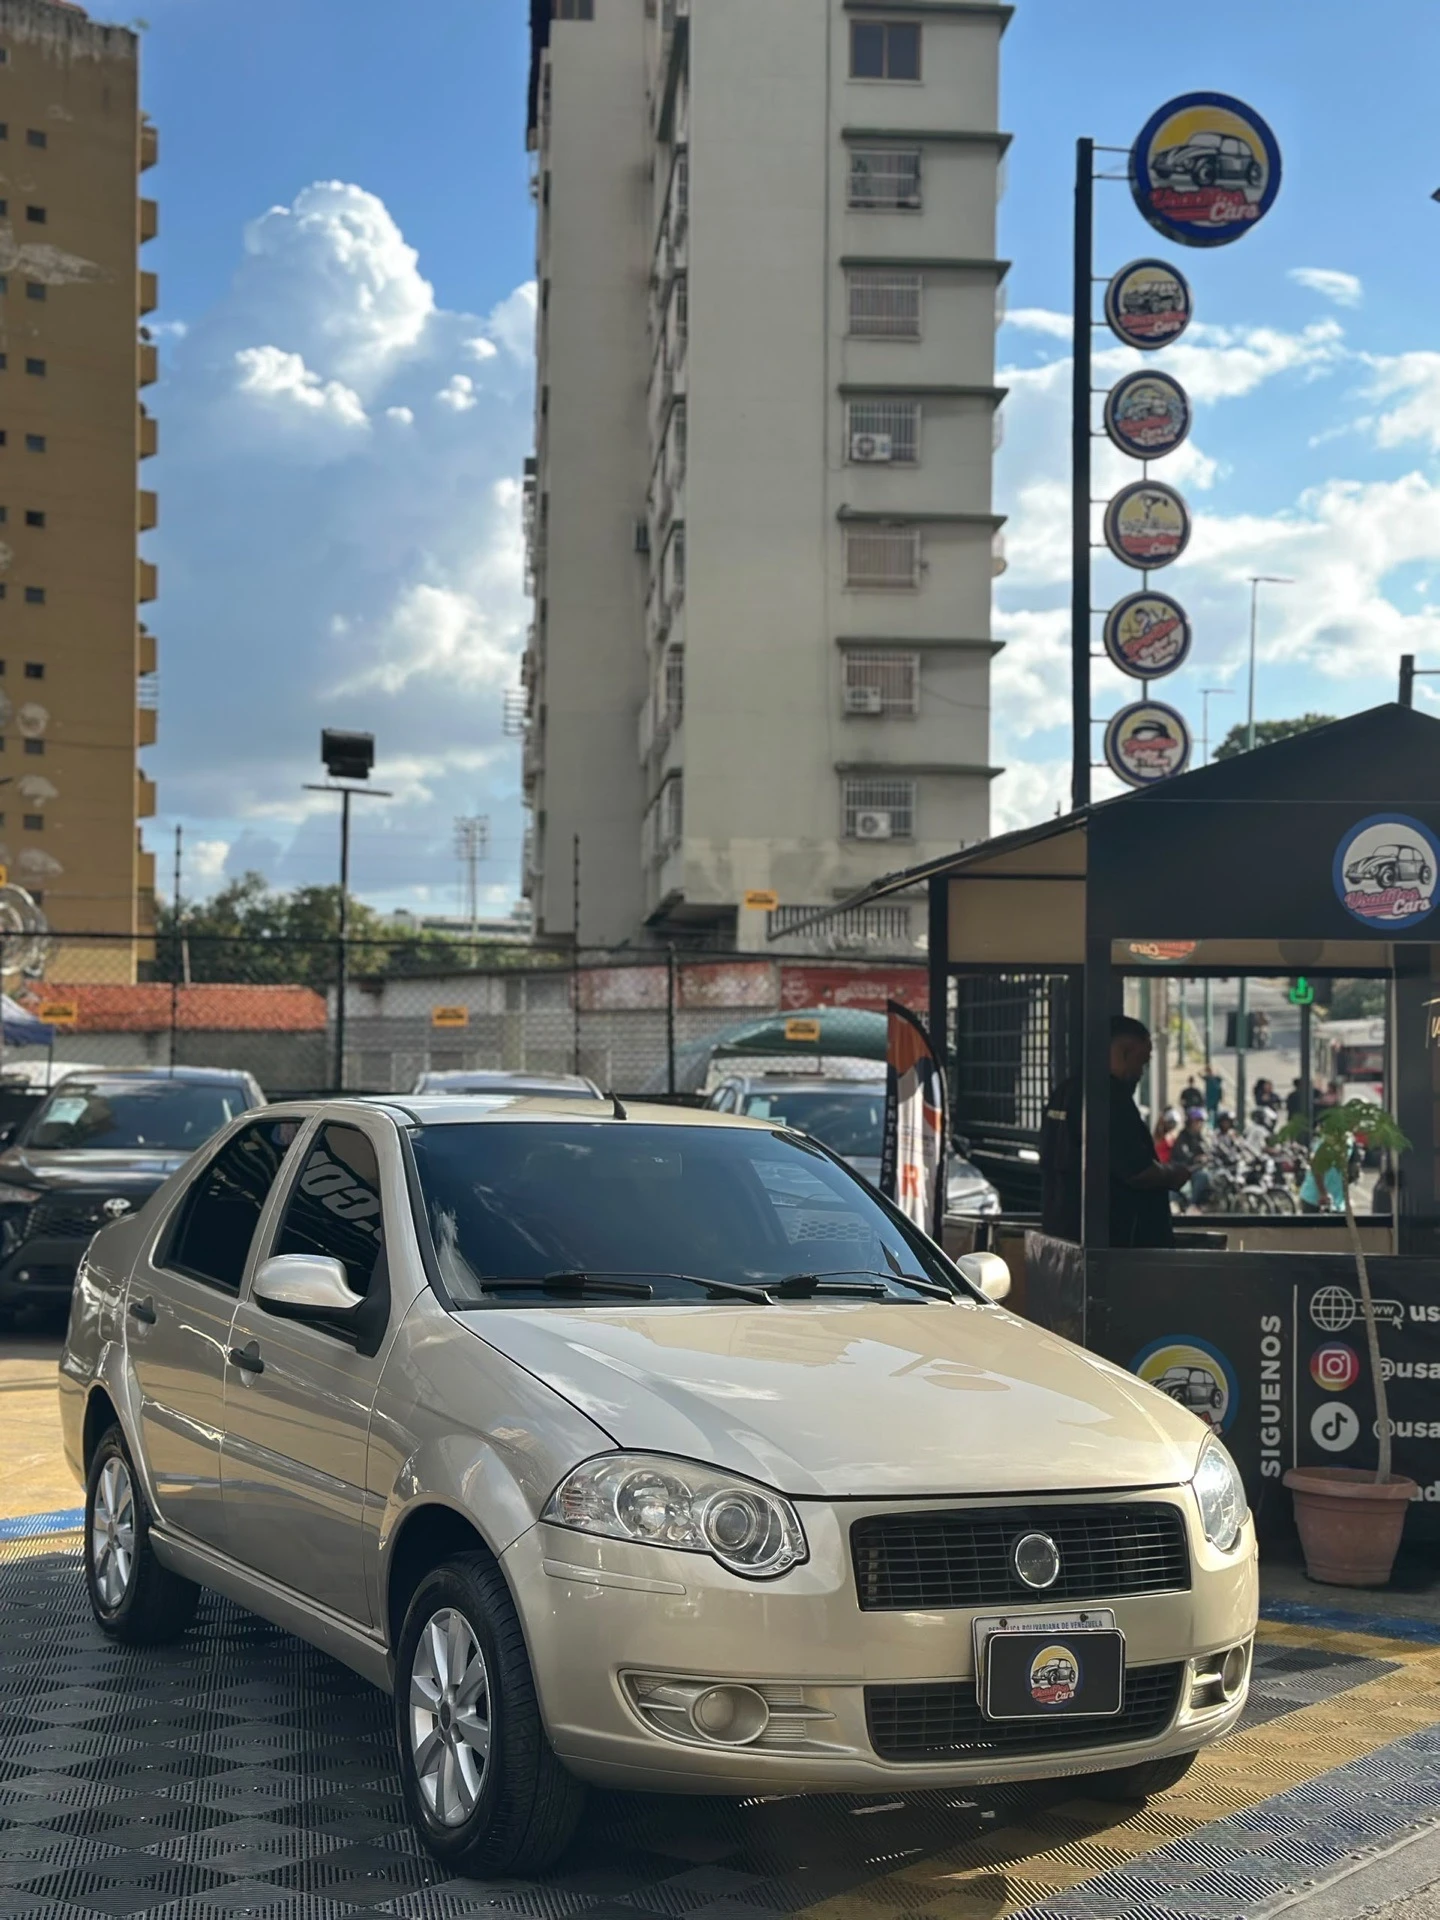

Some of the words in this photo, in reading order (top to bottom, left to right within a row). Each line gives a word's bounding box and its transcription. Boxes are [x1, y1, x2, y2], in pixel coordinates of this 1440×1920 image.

[1210, 202, 1259, 221] Cars
[1393, 897, 1431, 915] Cars
[1260, 1315, 1281, 1478] SIGUENOS
[1055, 1690, 1075, 1701] Cars
